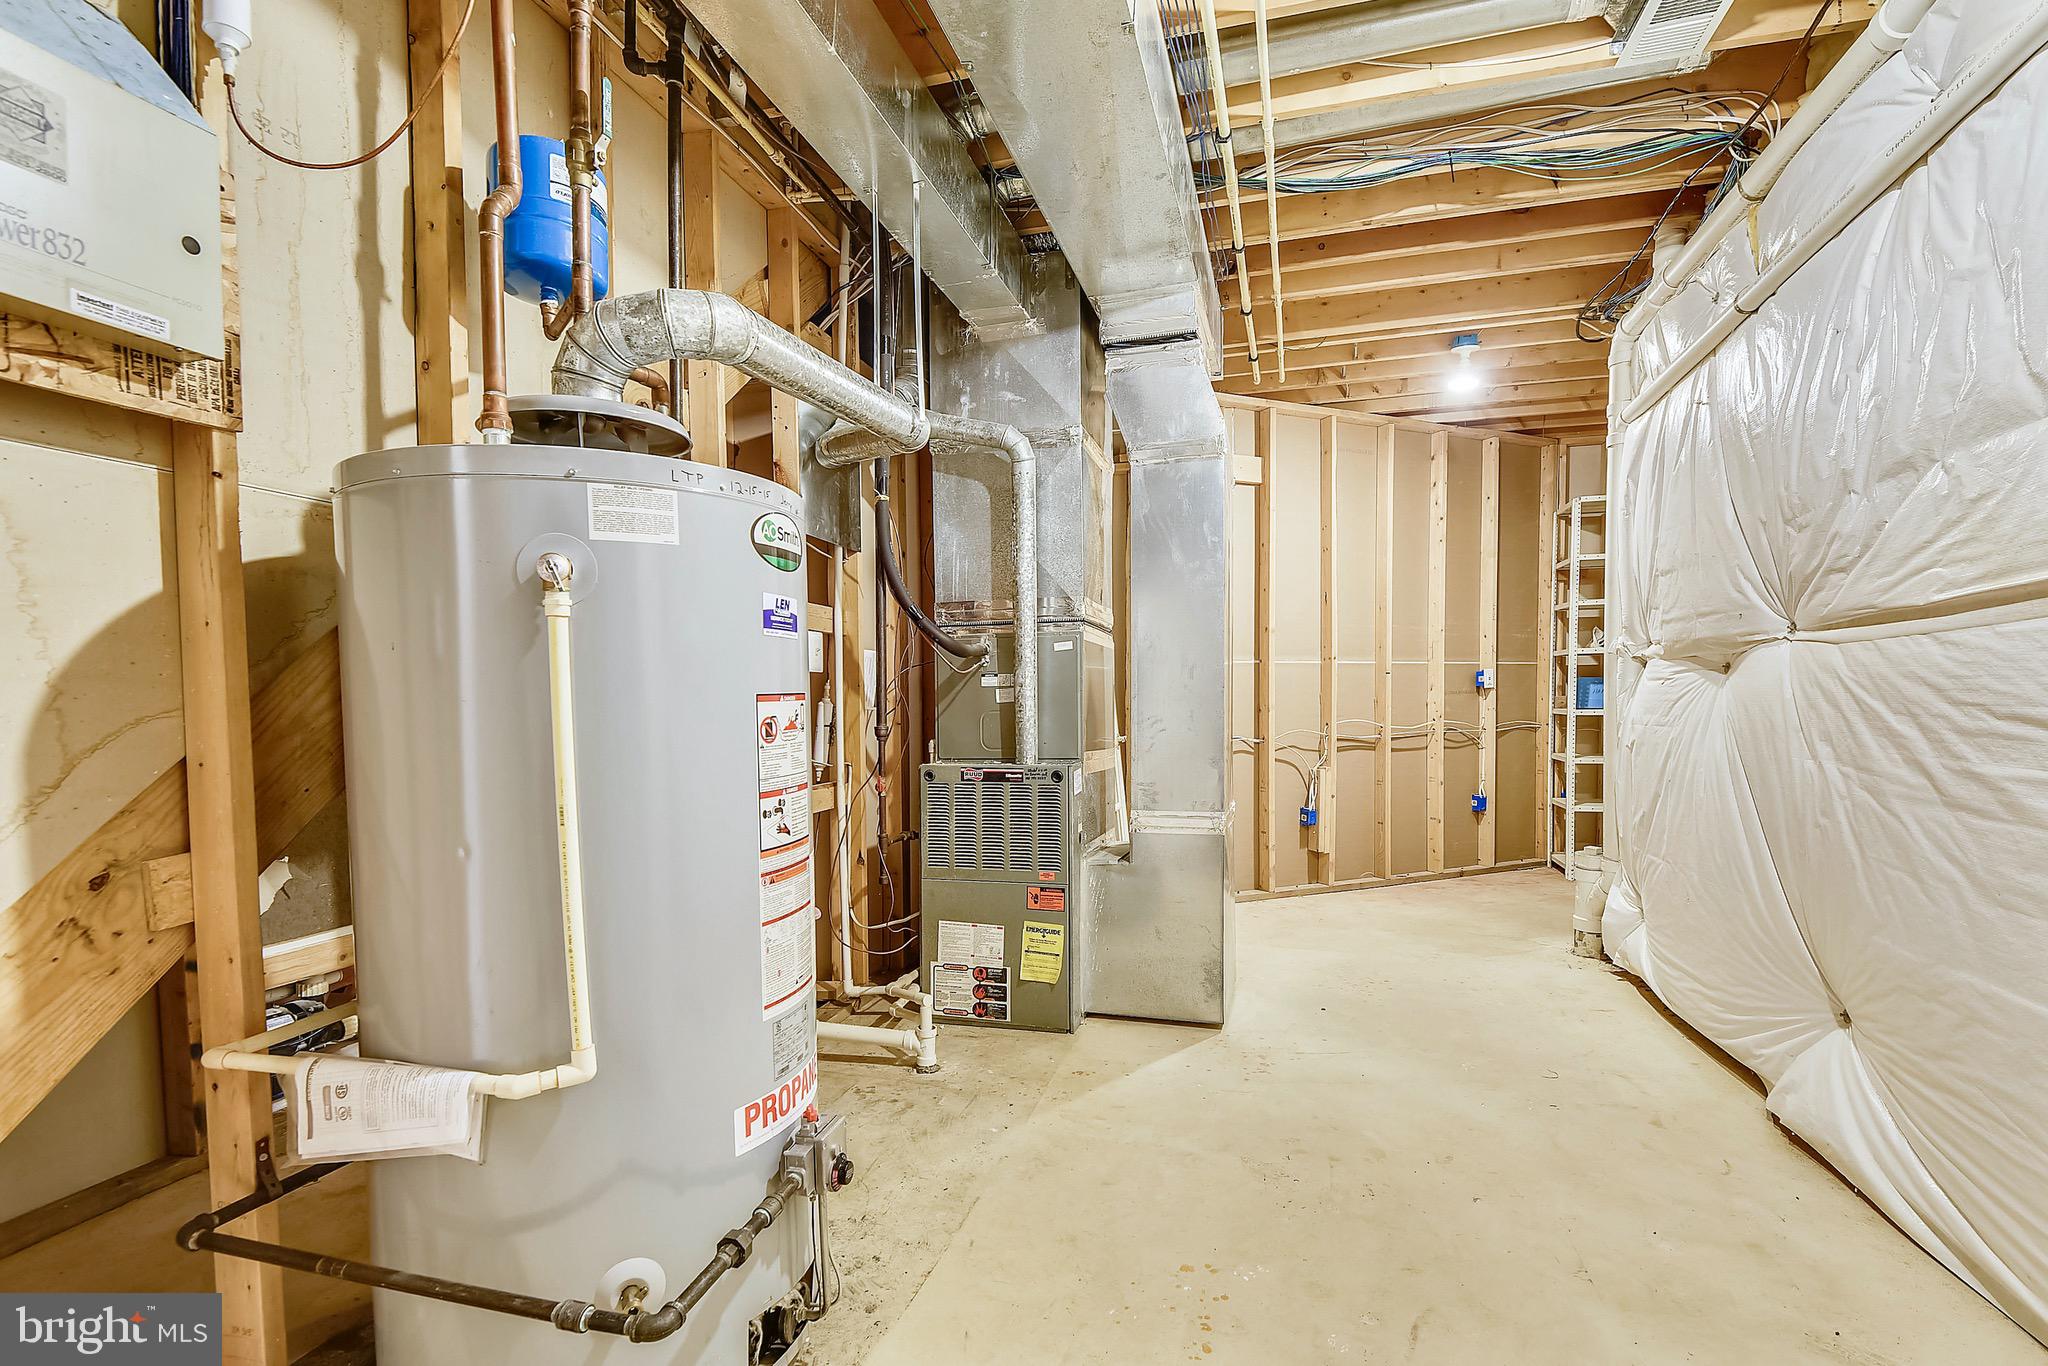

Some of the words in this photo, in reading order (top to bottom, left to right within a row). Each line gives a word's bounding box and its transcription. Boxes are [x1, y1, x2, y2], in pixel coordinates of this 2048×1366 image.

[1885, 102, 1942, 158] CHARLOTTE
[1947, 70, 1976, 99] PIPE
[730, 480, 771, 499] 12-15-15
[775, 597, 791, 611] LEN
